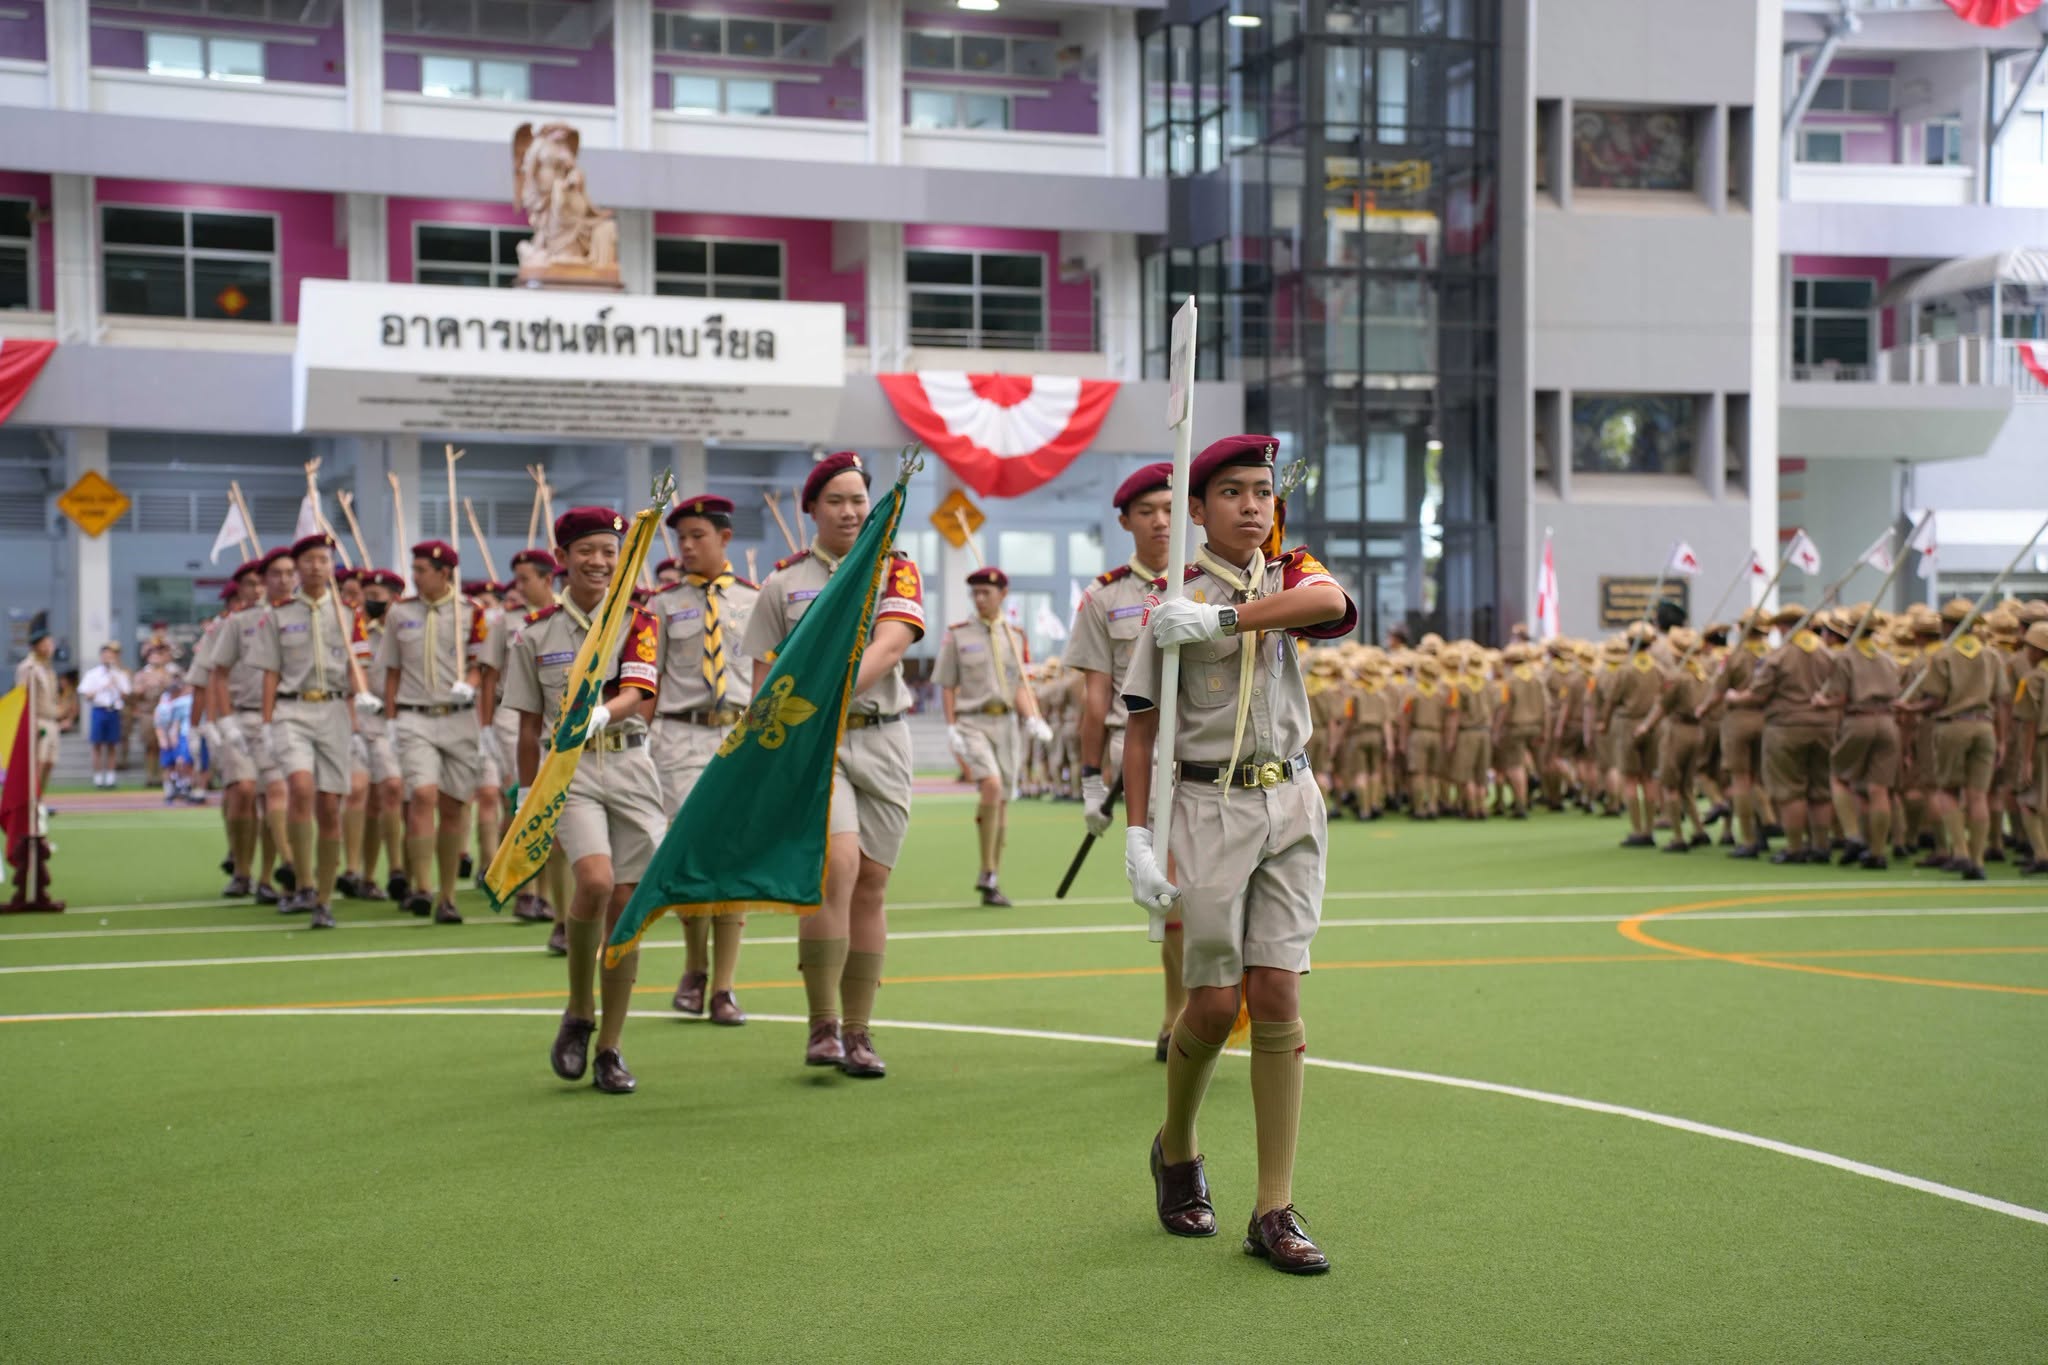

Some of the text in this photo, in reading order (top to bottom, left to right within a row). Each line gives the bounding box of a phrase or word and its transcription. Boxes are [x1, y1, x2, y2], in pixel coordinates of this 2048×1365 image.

[381, 306, 776, 361] อาคารเซนต์คาเบรียล
